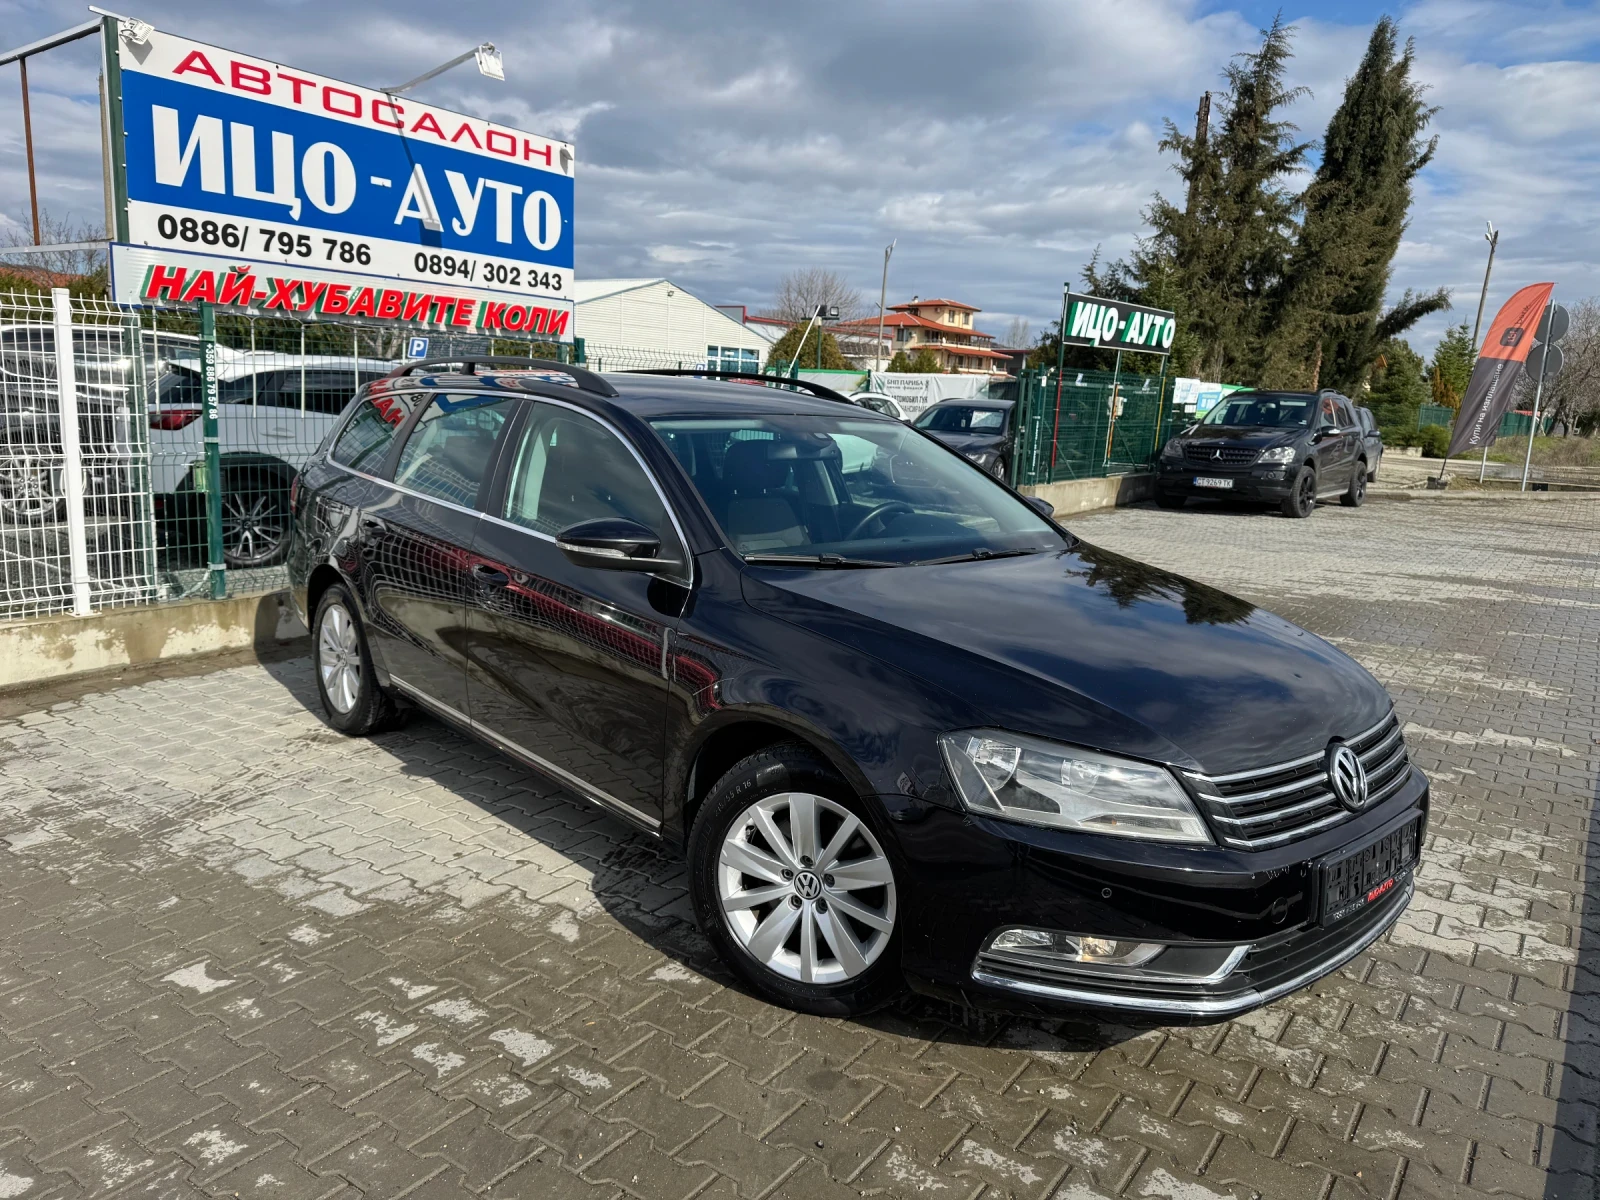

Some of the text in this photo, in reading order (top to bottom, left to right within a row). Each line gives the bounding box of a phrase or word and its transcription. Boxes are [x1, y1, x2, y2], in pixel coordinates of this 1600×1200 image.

[172, 50, 551, 167] АВТОСАЛОН
[157, 213, 372, 266] 0886/ 795 786
[414, 252, 562, 291] 0894/ 302 343
[145, 264, 570, 336] НАЙ-ХУБАВИТЕ КОЛИ
[1070, 301, 1176, 349] ИЦО-АУТО
[205, 343, 215, 364] +359
[411, 339, 424, 356] P
[206, 366, 215, 382] 886
[207, 384, 216, 395] 79
[1468, 363, 1504, 445] Купи на изплащане
[209, 409, 219, 420] 86
[1205, 478, 1222, 487] 9269
